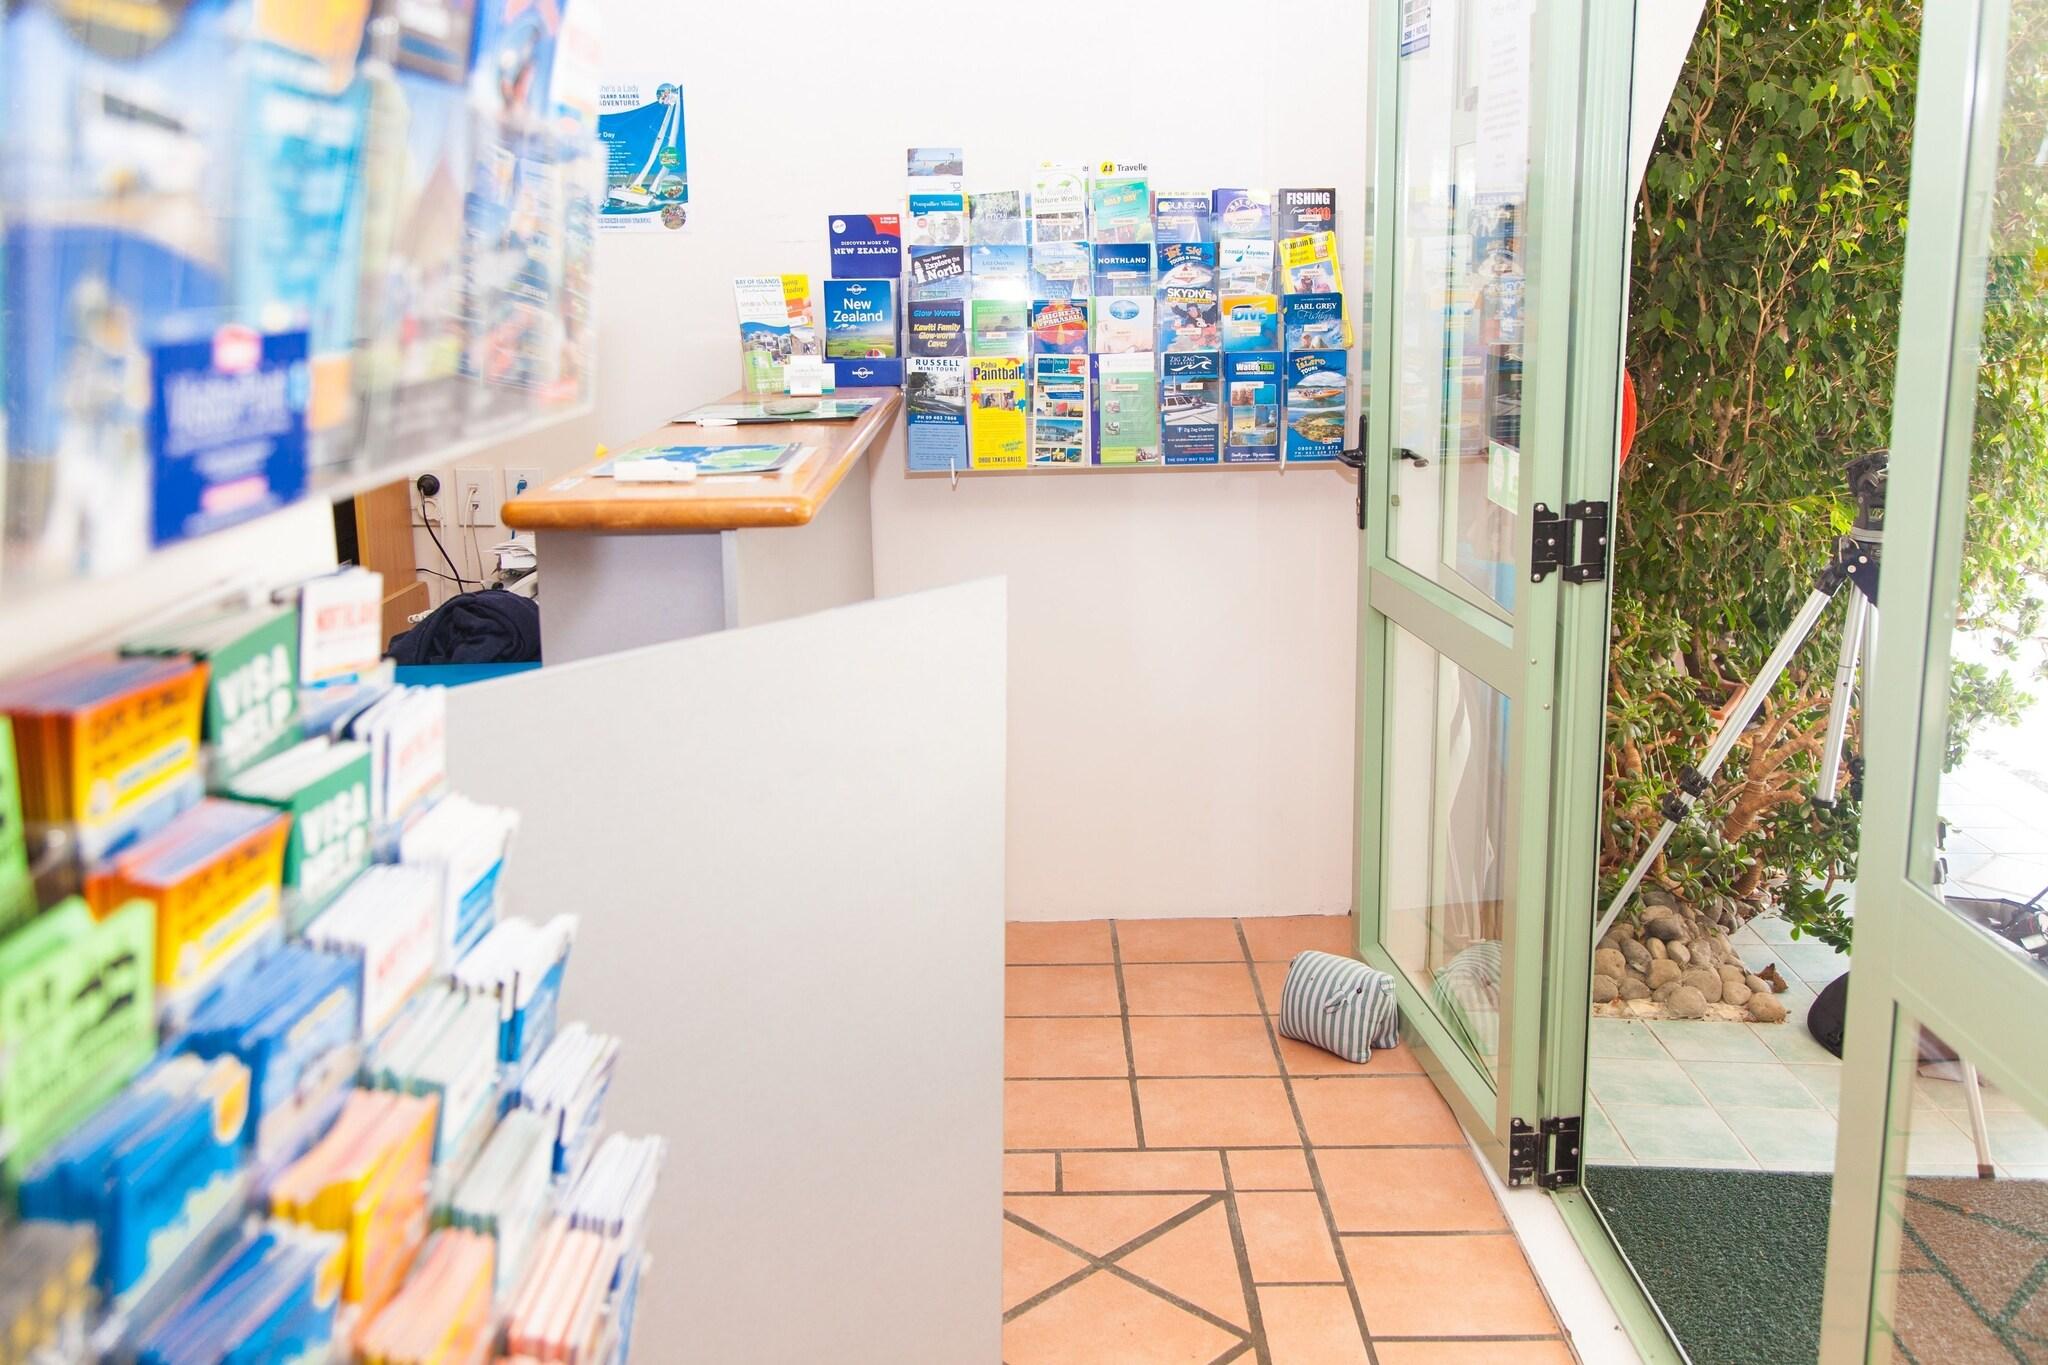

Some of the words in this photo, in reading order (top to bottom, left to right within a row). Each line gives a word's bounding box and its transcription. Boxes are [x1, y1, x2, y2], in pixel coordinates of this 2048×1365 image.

[603, 131, 615, 139] Day
[1287, 191, 1331, 205] FISHING
[857, 247, 898, 255] ZEALAND
[924, 258, 951, 271] Explore
[926, 263, 962, 281] North
[1167, 288, 1212, 299] SKYDIVE
[843, 298, 871, 309] New
[1315, 302, 1337, 310] GREY
[833, 311, 883, 323] Zealand
[1234, 311, 1268, 321] DIVE
[937, 324, 961, 332] Family
[927, 340, 948, 348] Caves
[915, 358, 960, 367] RUSSELL
[1235, 363, 1259, 372] Water
[1260, 362, 1275, 371] Taxi
[973, 366, 1022, 381] Paintball
[1300, 366, 1318, 375] TOURS
[216, 643, 292, 721] VISA
[302, 782, 369, 854] VISA
